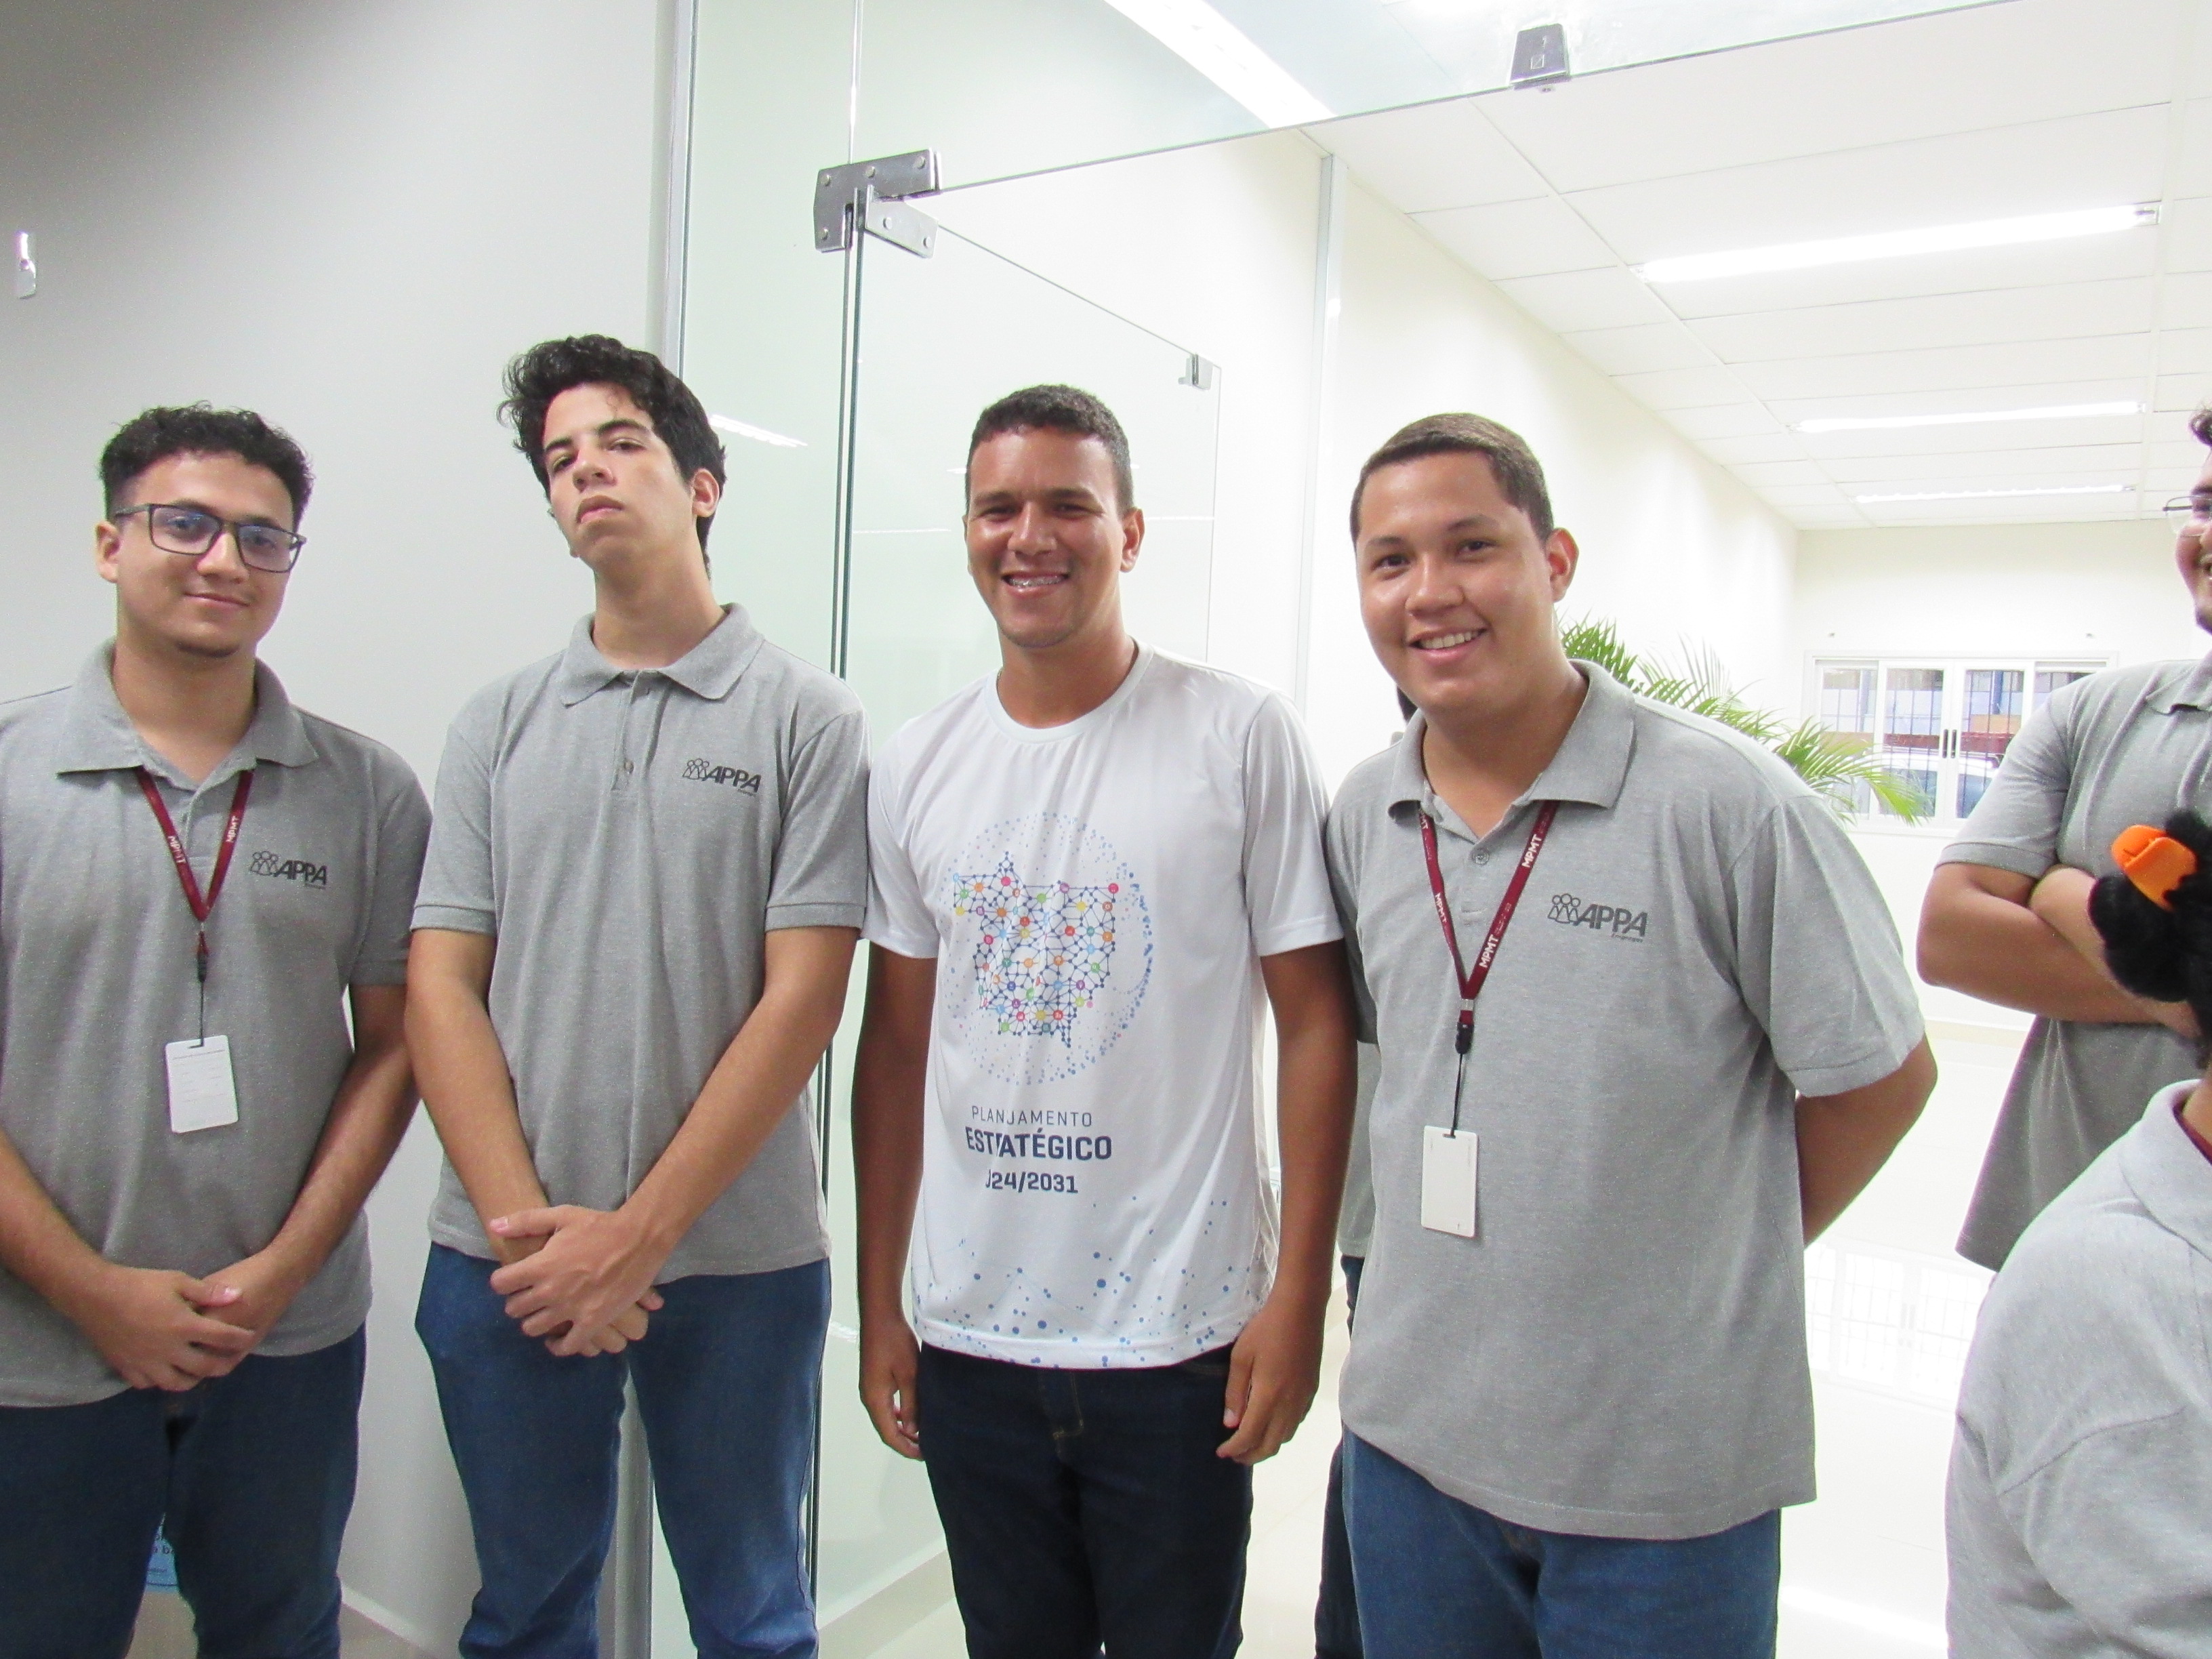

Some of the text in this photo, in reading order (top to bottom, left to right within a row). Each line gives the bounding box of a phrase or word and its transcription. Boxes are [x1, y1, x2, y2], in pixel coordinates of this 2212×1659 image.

[702, 765, 762, 793] APPA
[1521, 834, 1542, 868] MPMT
[273, 860, 327, 885] APPA
[1572, 903, 1648, 937] APPA
[1479, 934, 1498, 968] MPMT
[972, 1105, 1092, 1127] PLANJAMENTO
